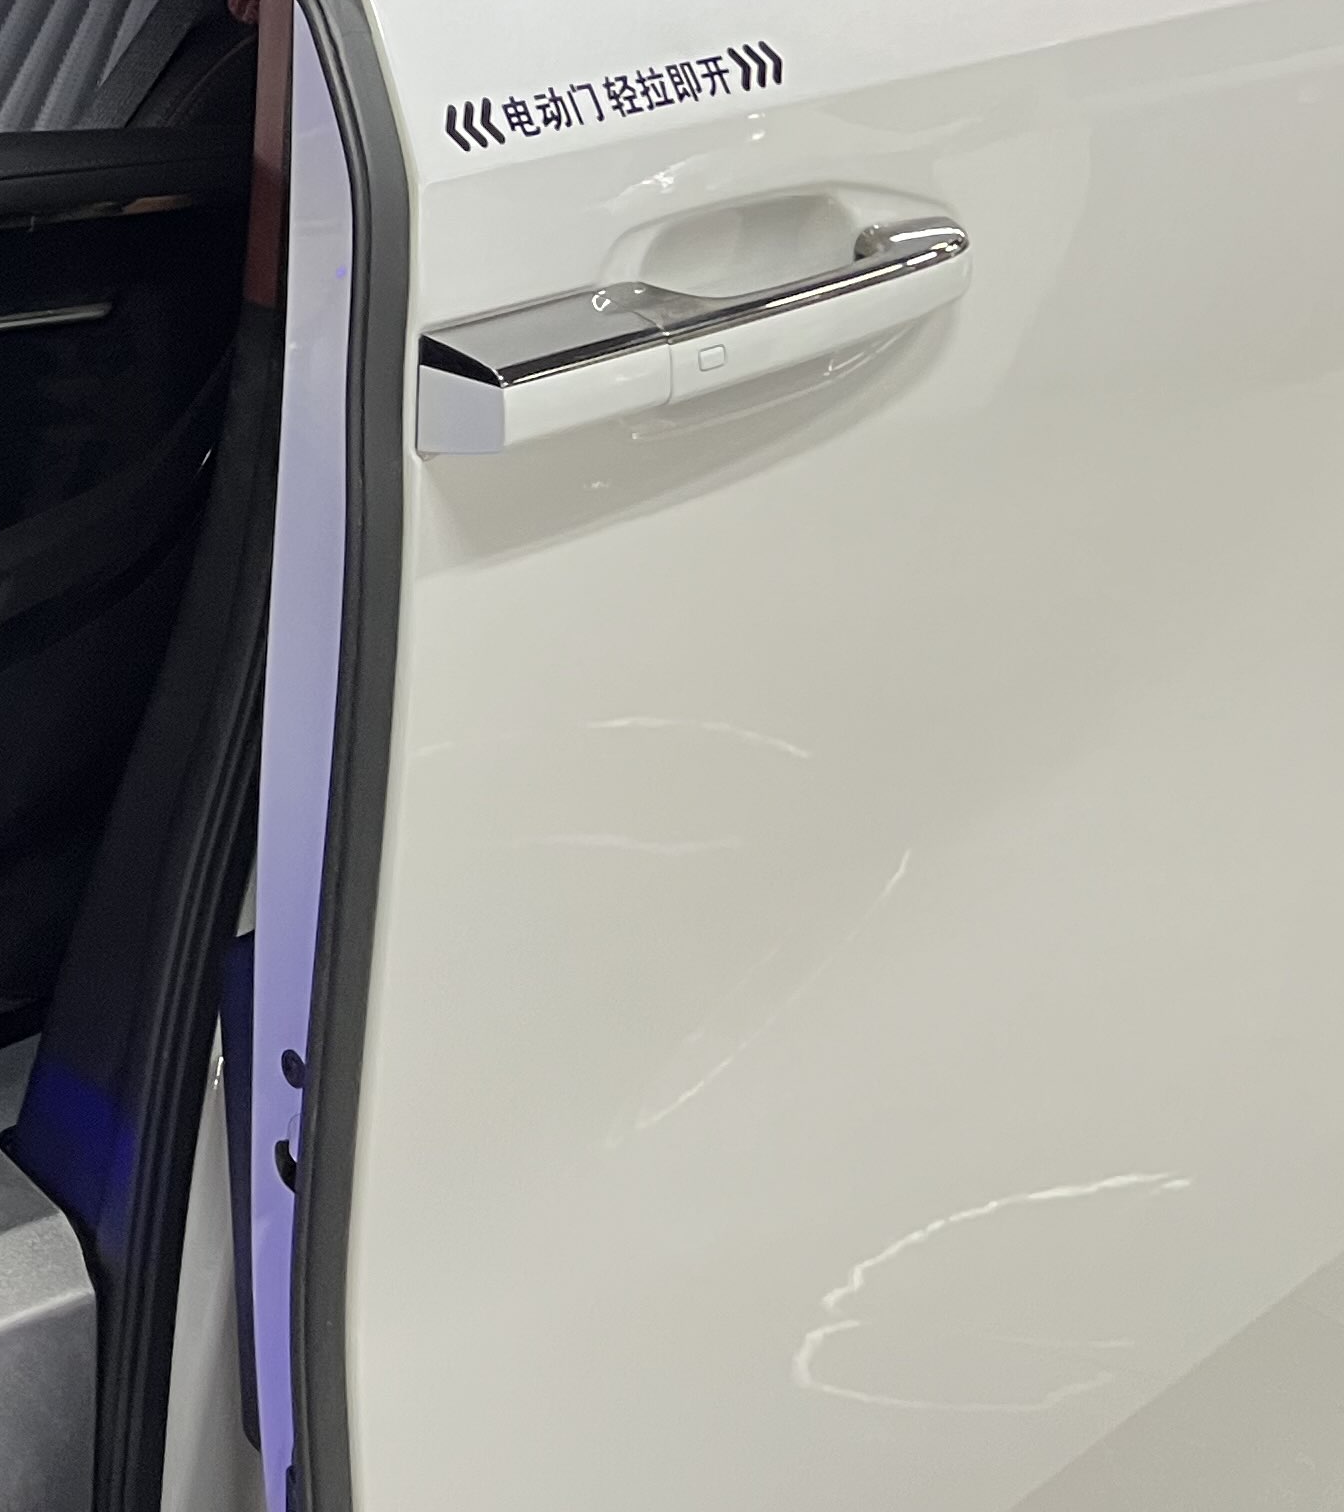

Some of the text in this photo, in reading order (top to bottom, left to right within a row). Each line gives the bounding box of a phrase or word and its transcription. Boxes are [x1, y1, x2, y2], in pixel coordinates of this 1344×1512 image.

[502, 54, 732, 138] 电动门 轻拉即开
